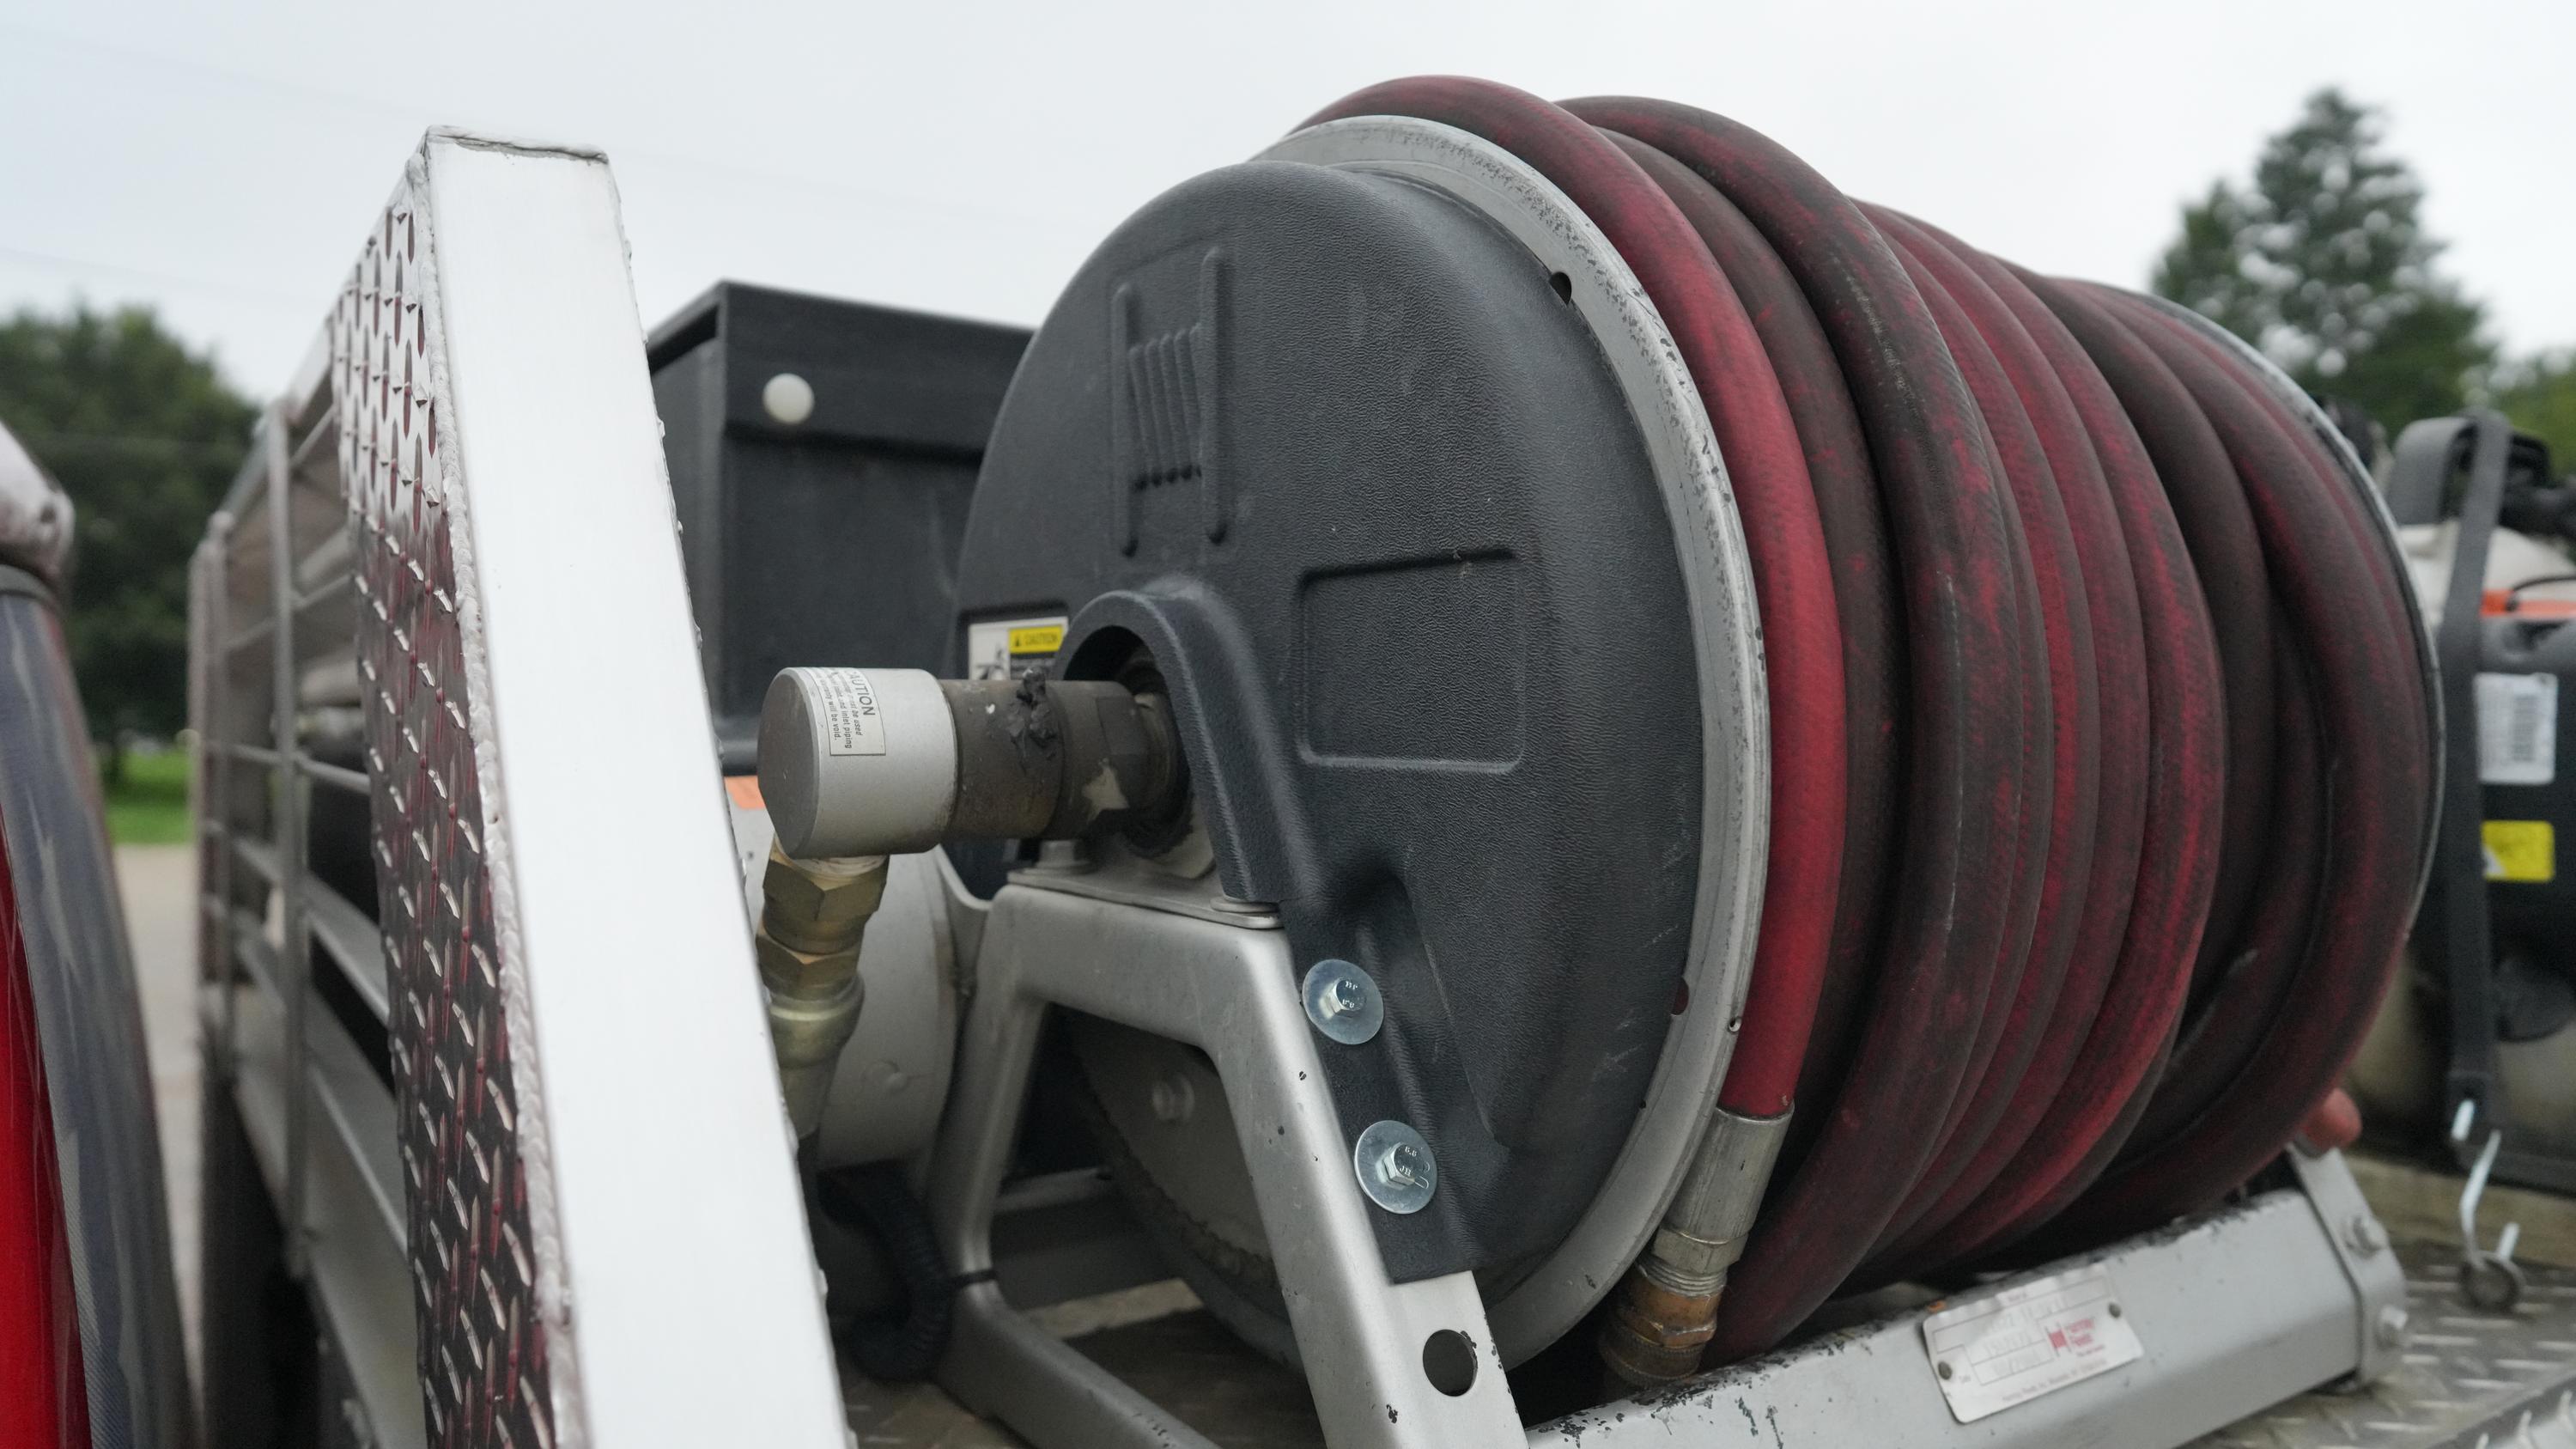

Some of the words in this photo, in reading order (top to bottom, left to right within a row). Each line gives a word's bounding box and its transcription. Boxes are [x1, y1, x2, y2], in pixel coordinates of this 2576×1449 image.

[833, 723, 841, 740] void.
[854, 719, 863, 736] used
[843, 727, 852, 748] piping
